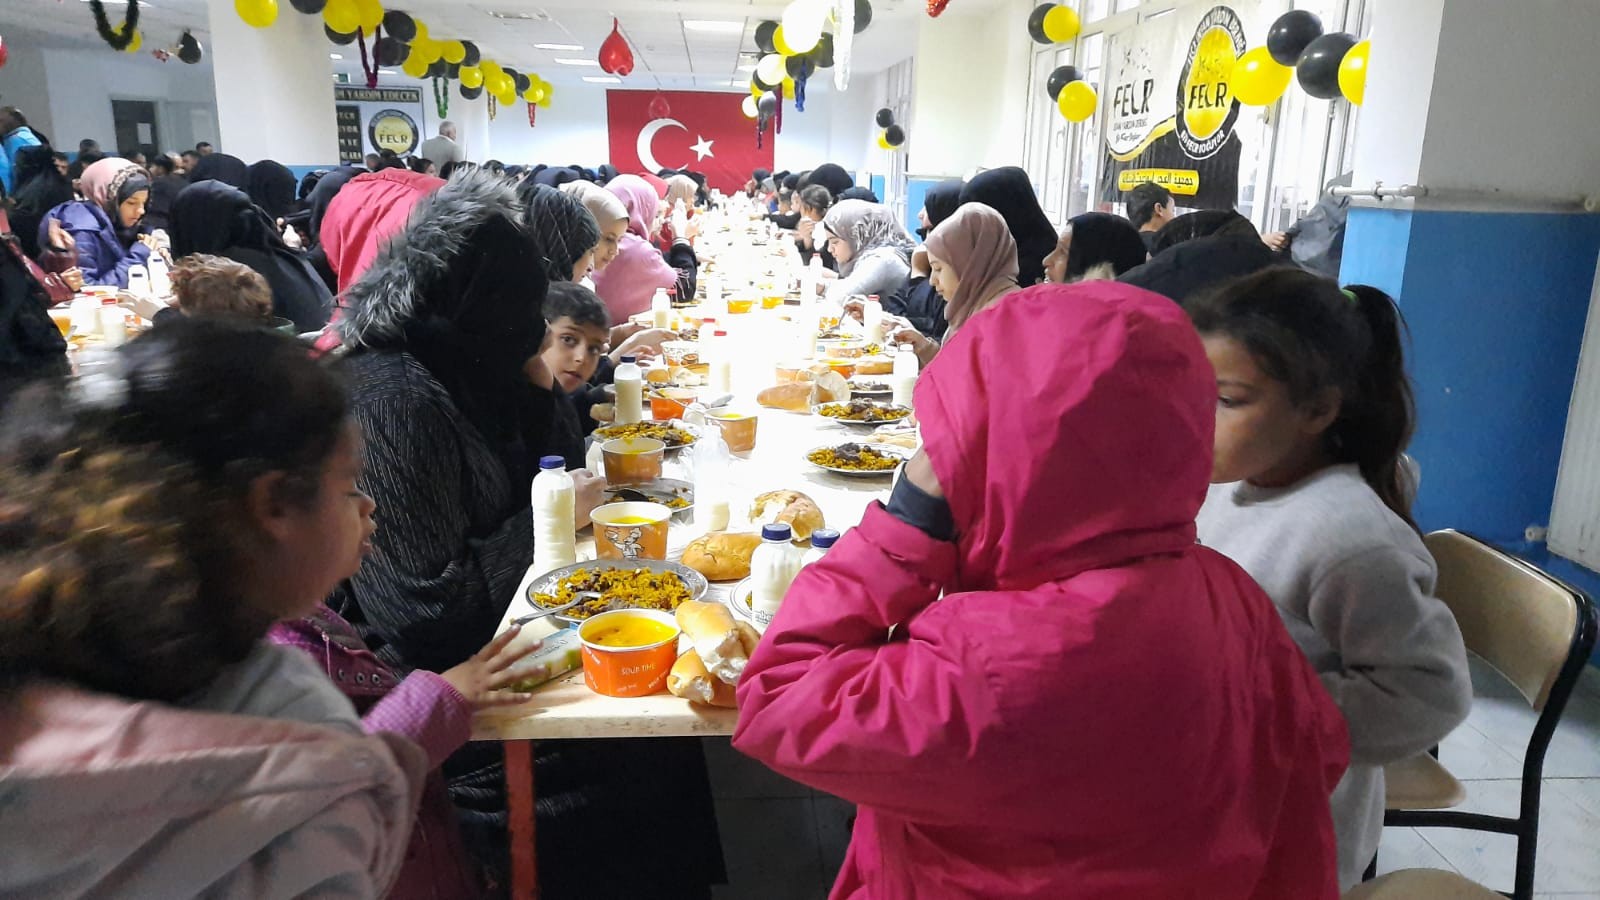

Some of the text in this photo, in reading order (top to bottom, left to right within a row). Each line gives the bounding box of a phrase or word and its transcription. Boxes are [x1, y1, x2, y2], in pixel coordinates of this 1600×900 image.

[1113, 79, 1154, 117] FECR
[1188, 82, 1227, 110] FECR
[379, 134, 408, 144] FECR
